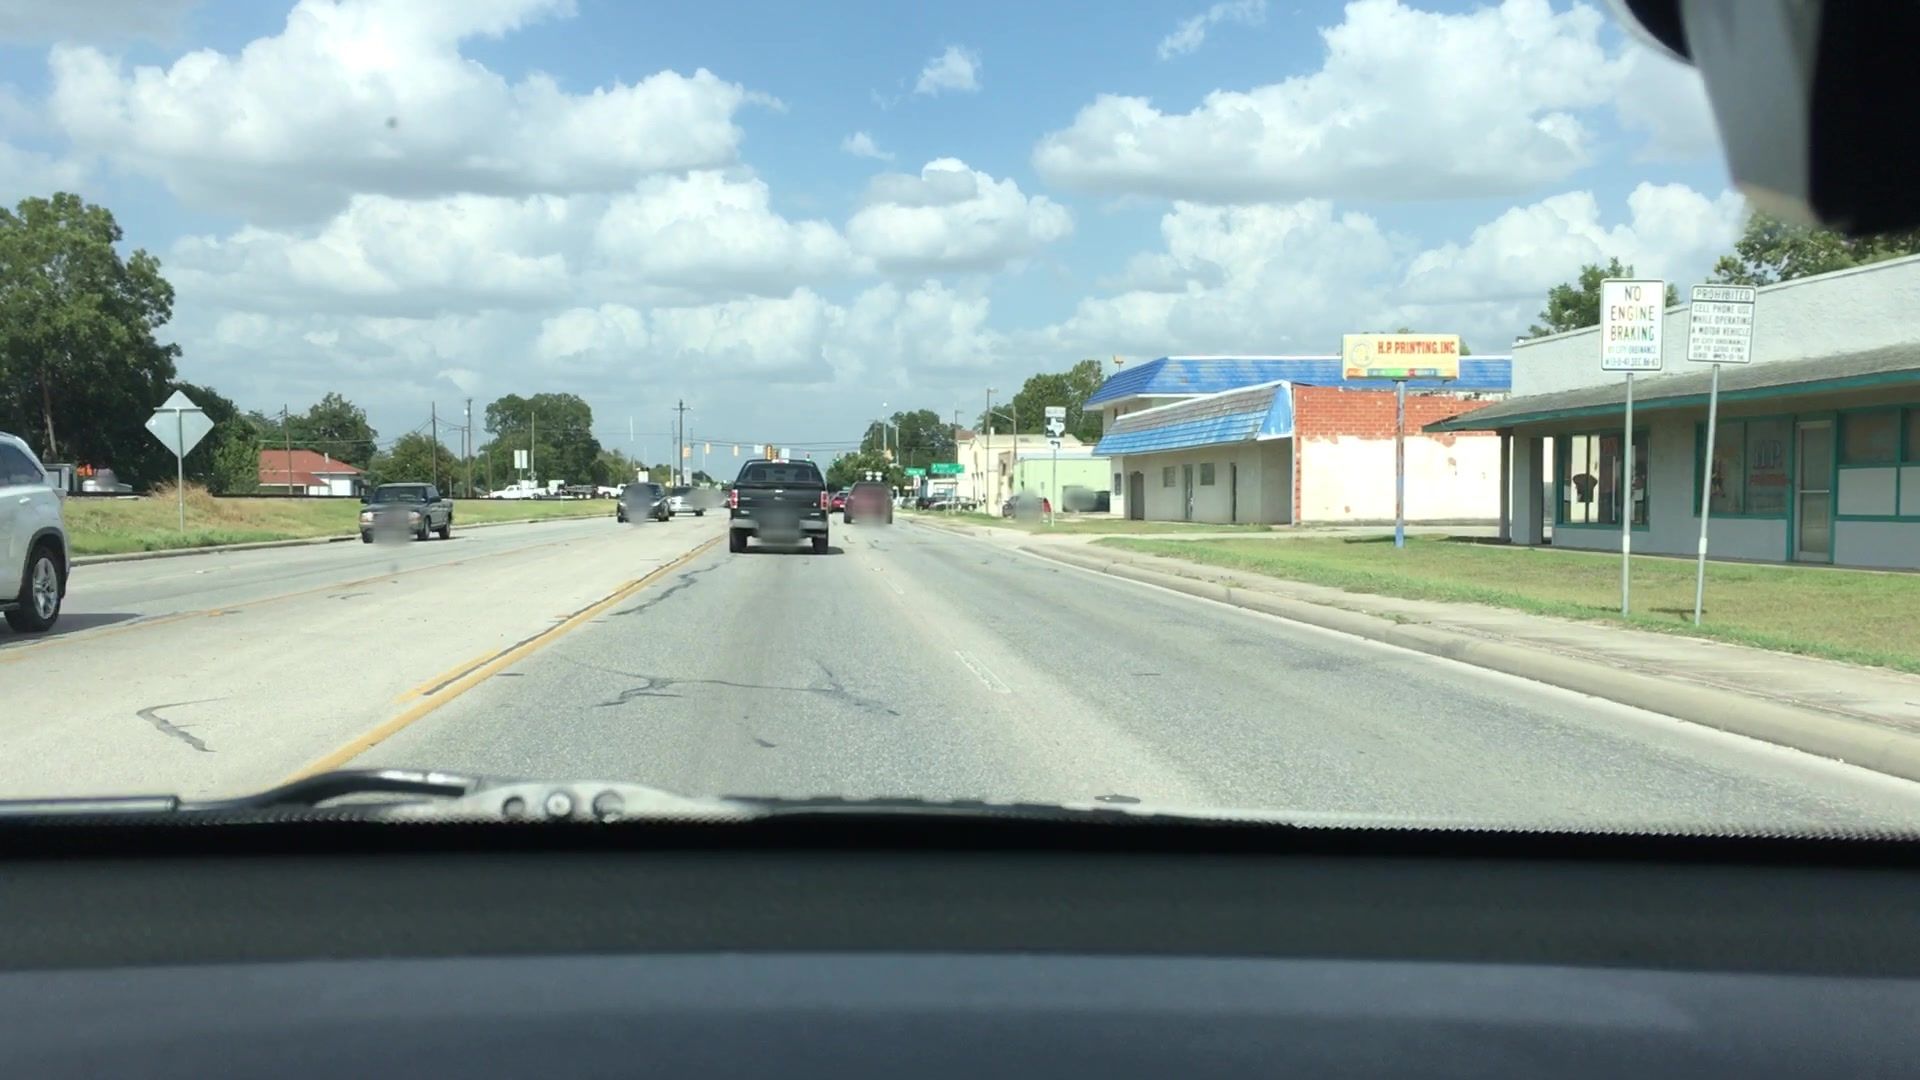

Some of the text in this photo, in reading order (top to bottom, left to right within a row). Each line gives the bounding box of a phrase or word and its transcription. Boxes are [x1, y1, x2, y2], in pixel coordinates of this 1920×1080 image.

[1625, 286, 1640, 302] NO
[1696, 288, 1750, 300] PROHIBITED
[1611, 306, 1654, 321] ENGINE
[1694, 304, 1750, 314] CELL PHONE USE
[1692, 316, 1751, 325] WHILE OPERATING
[1611, 326, 1654, 341] BRAKING
[1699, 326, 1720, 334] MOTOR
[1723, 328, 1750, 336] VEHICLE
